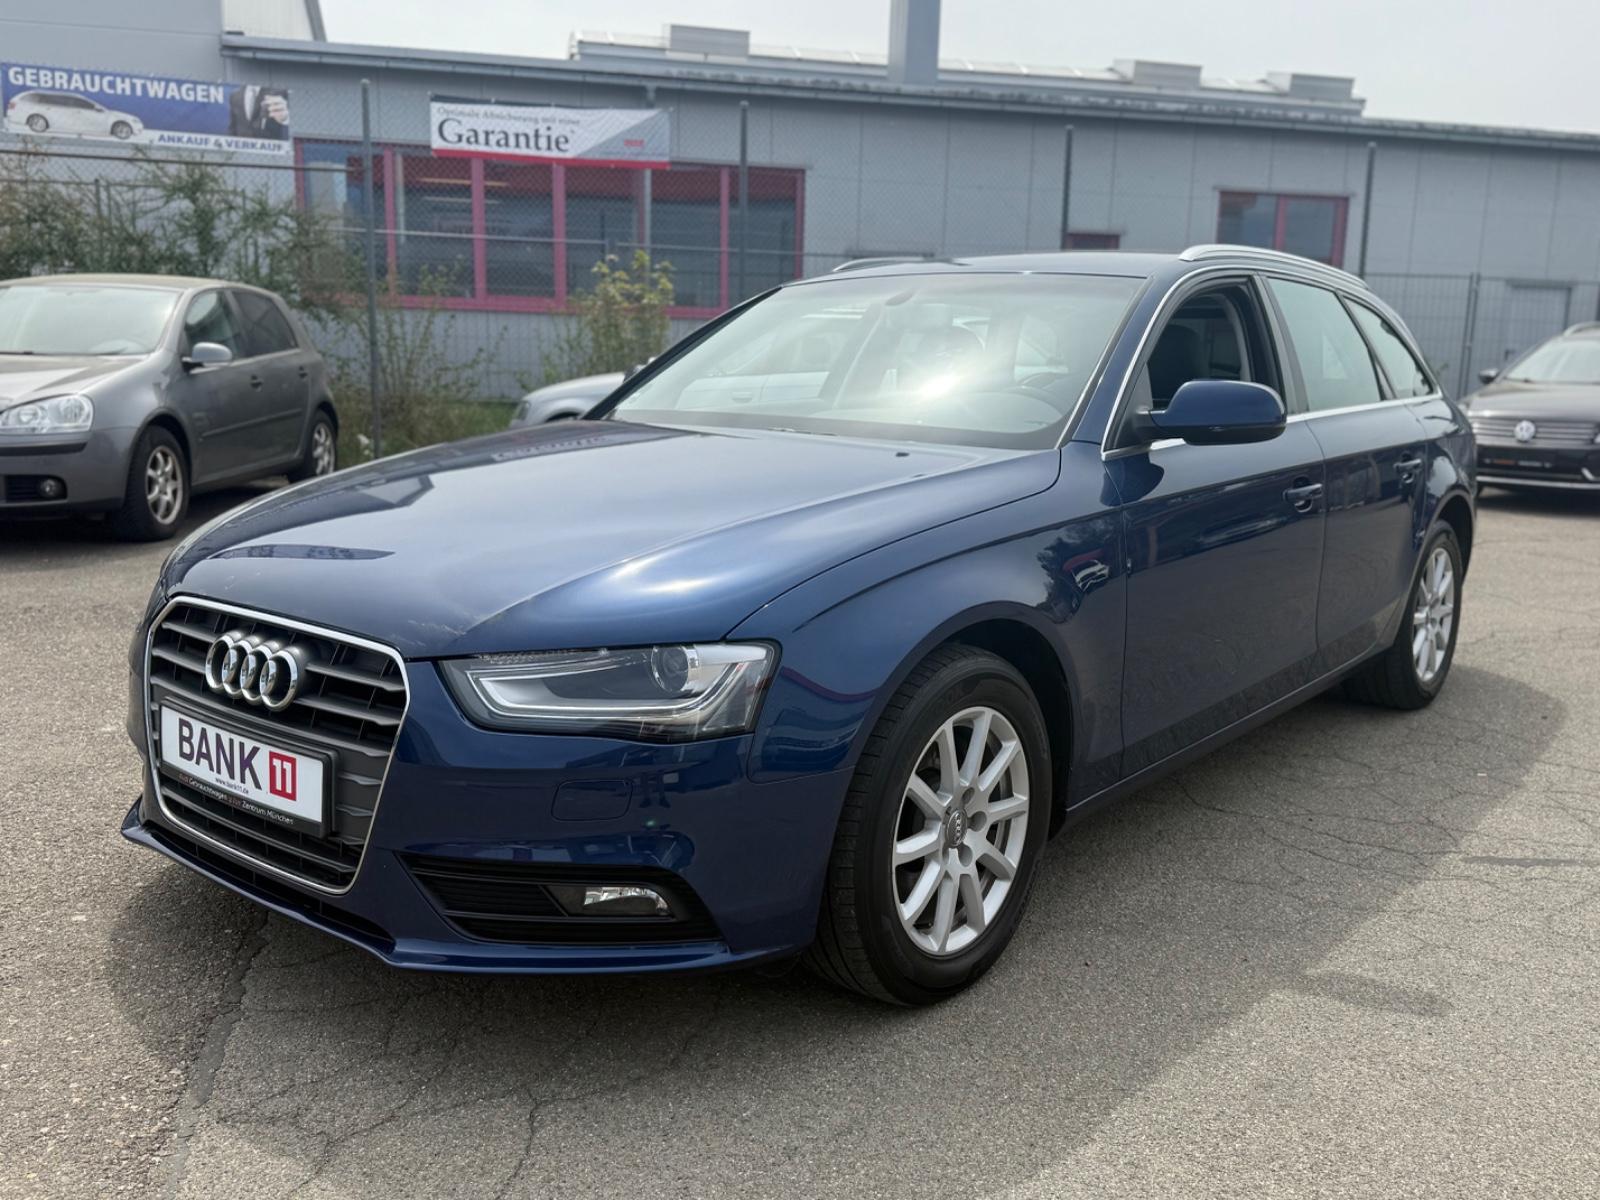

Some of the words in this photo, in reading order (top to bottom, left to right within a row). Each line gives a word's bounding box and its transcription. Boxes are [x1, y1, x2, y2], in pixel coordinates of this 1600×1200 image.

[8, 67, 224, 104] GEBRAUCHTWAGEN
[158, 134, 210, 147] ANKAUF
[213, 138, 223, 149] &
[226, 139, 284, 152] VERKAUF
[178, 717, 263, 791] BANK
[242, 800, 266, 815] Zentrum
